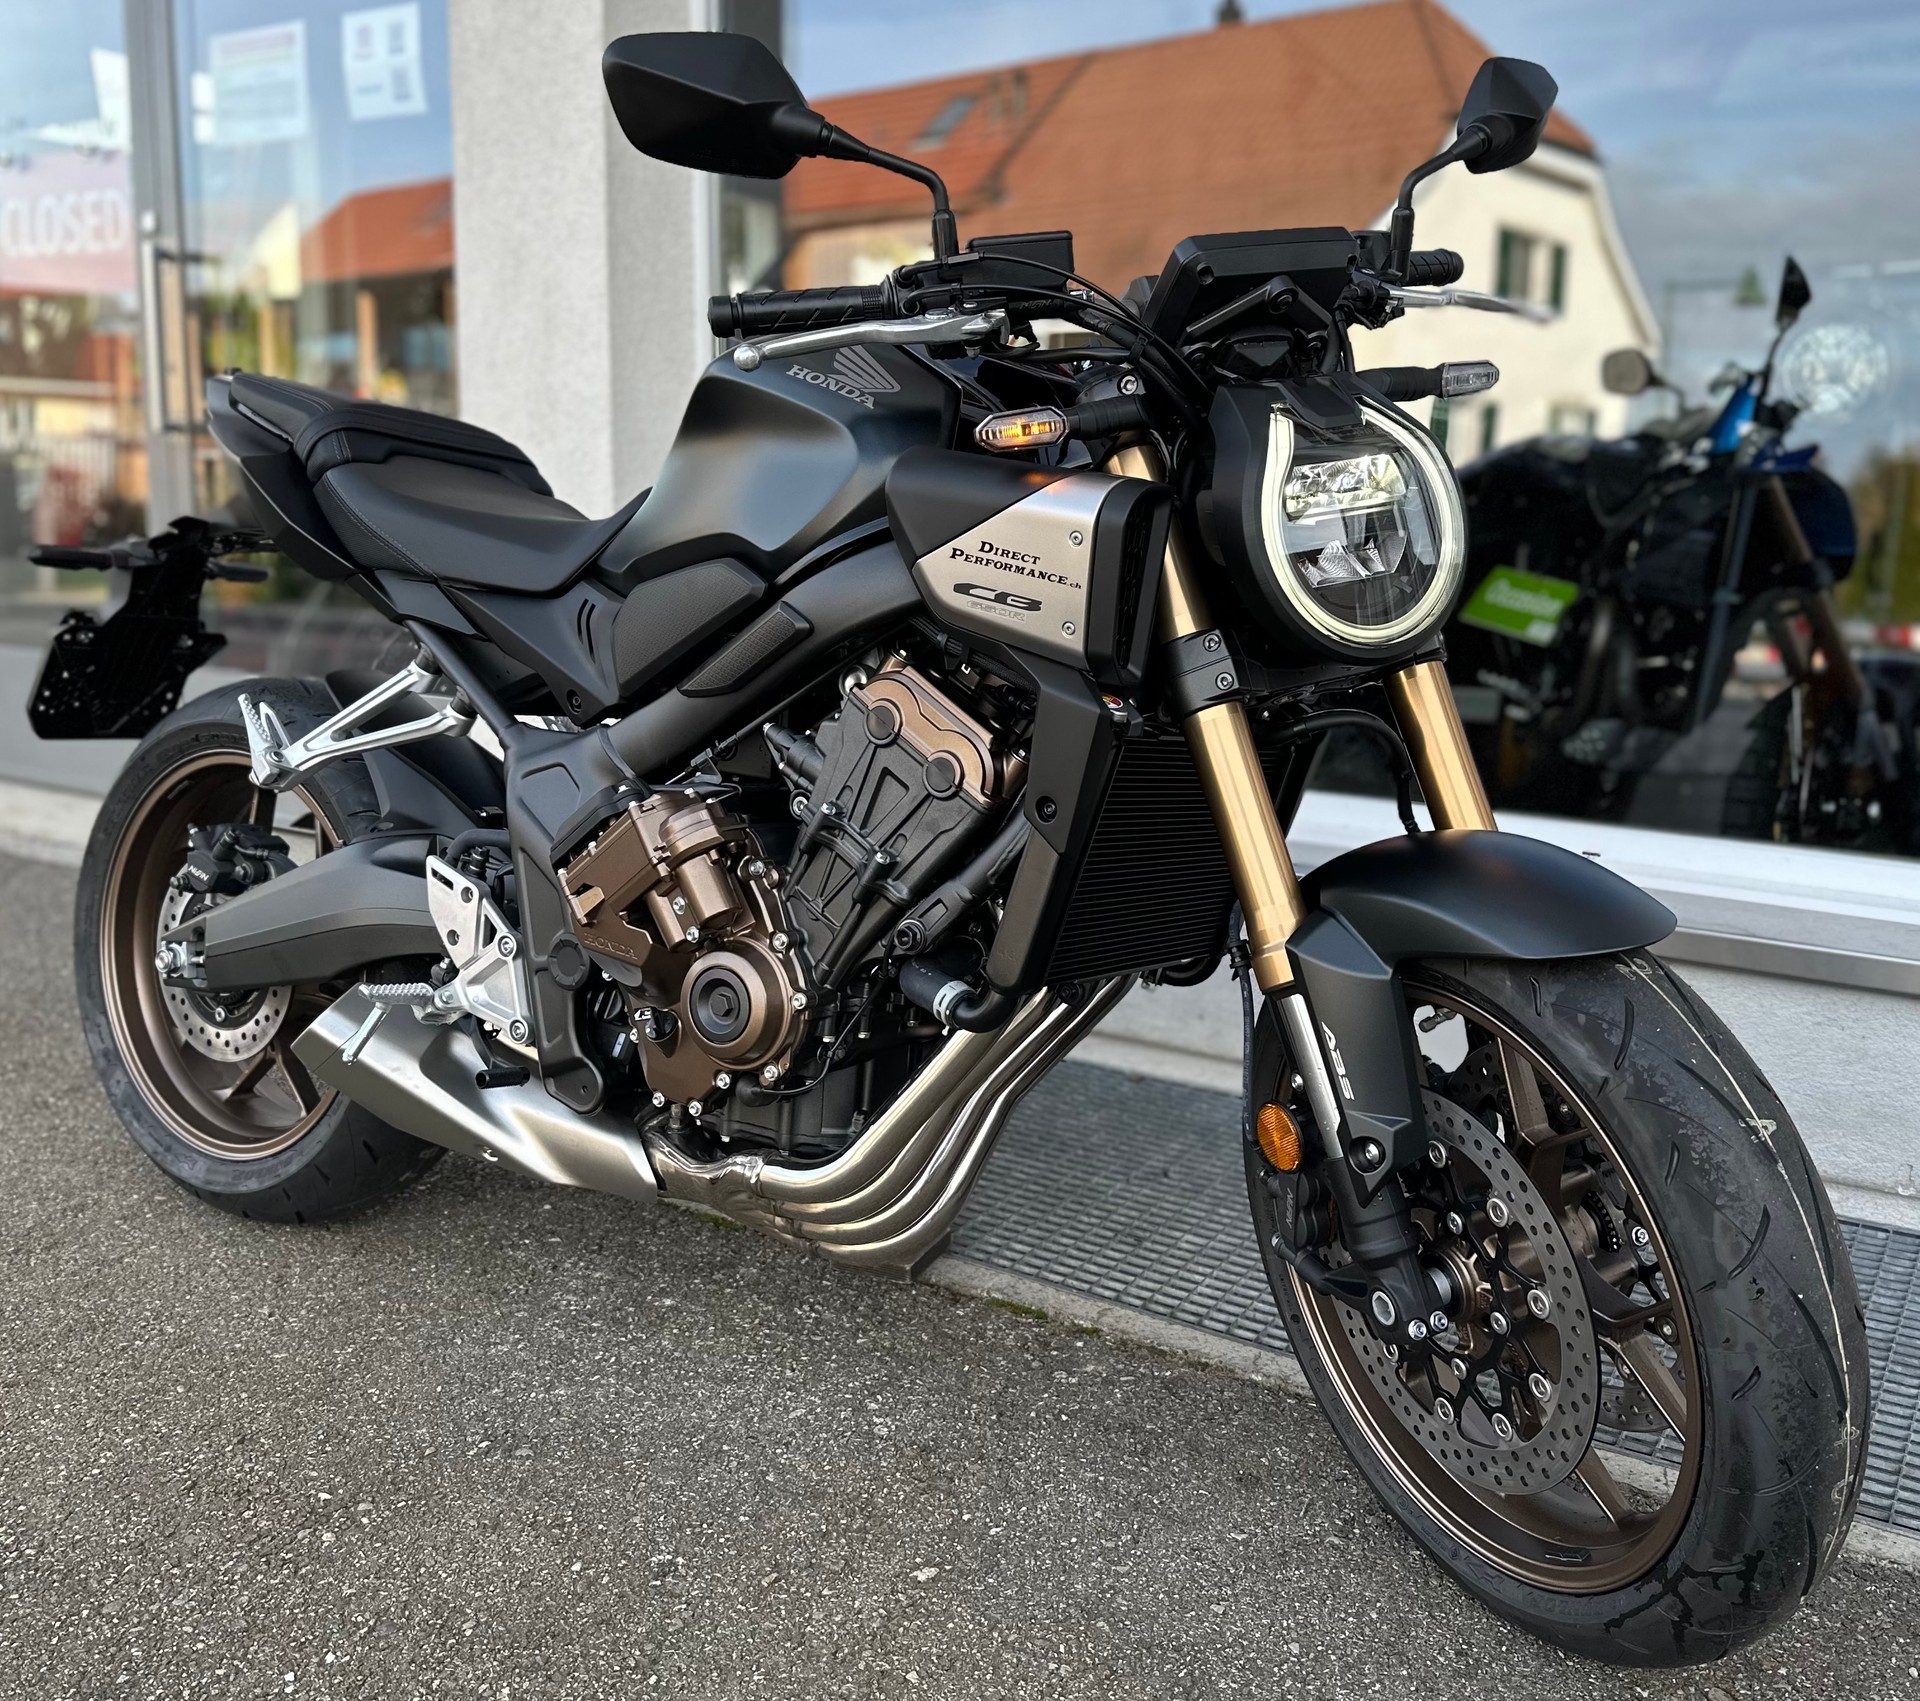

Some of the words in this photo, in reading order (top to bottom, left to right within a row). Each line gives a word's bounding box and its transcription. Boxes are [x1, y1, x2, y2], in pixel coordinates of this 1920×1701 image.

[0, 189, 128, 258] CLOSED
[786, 364, 875, 409] HONDA
[978, 540, 1041, 565] DIRECT
[953, 583, 1043, 612] CB
[584, 932, 638, 960] HONDA
[1321, 1021, 1355, 1101] ABS
